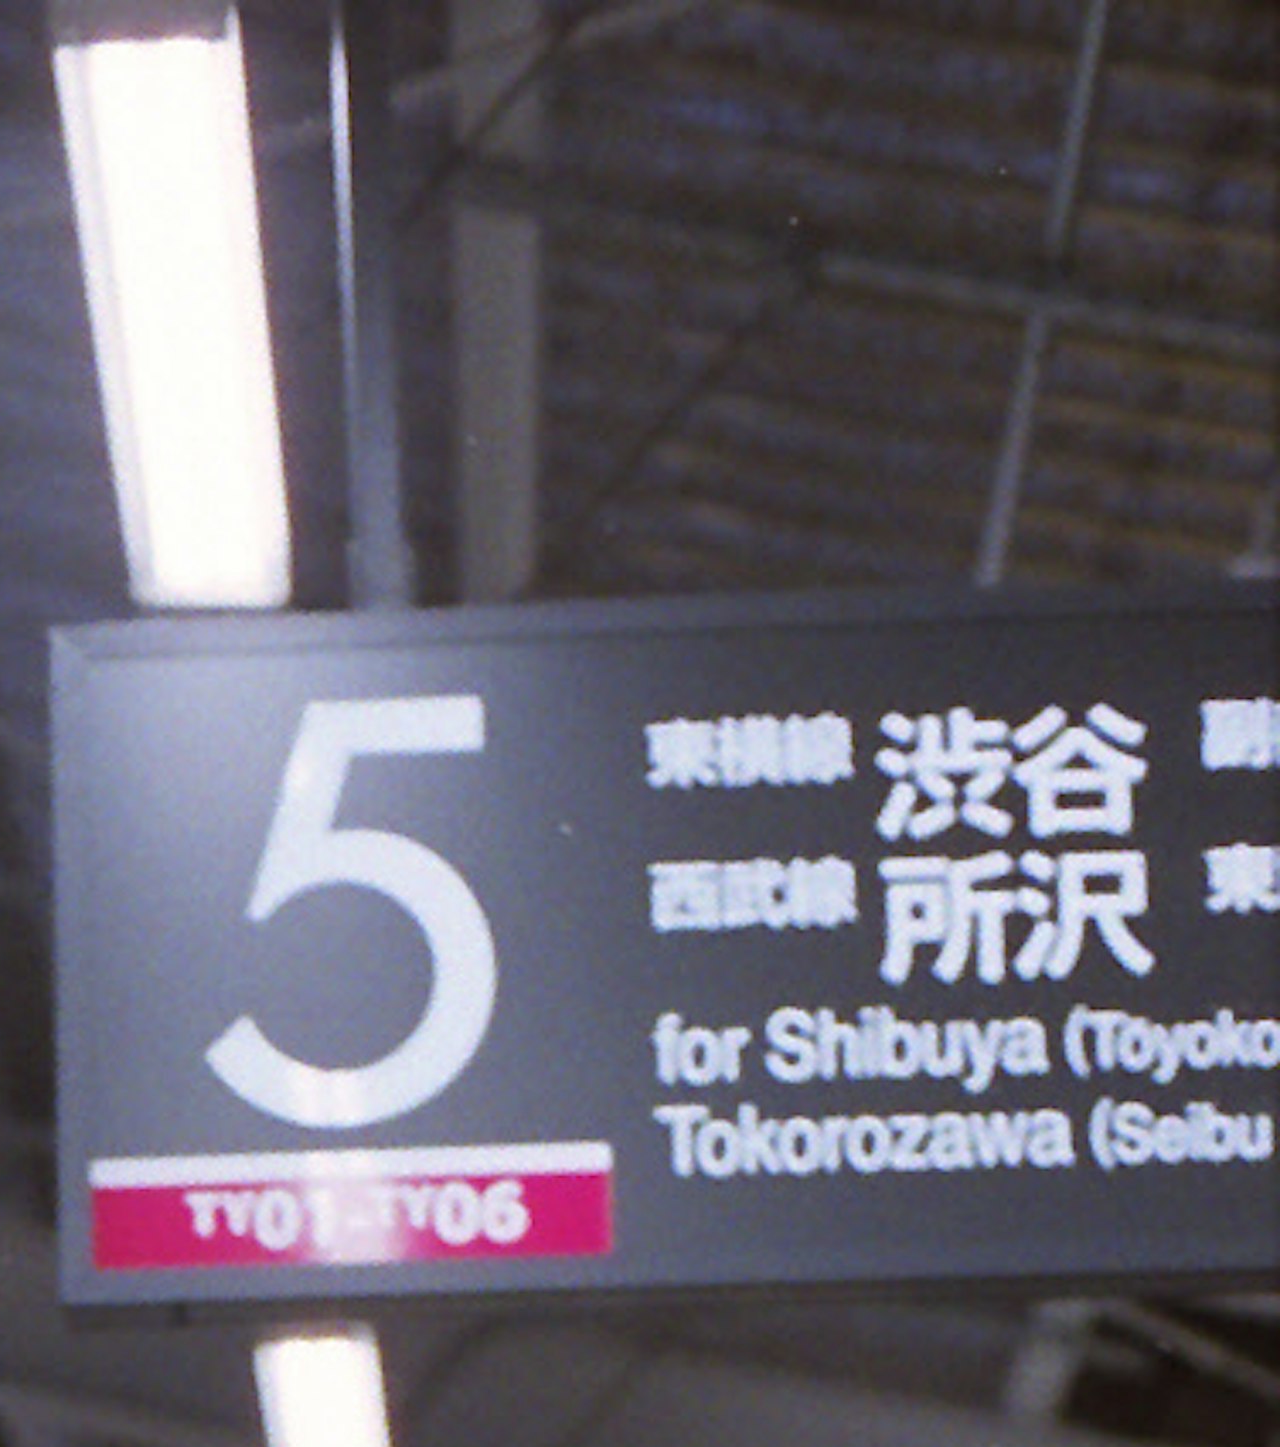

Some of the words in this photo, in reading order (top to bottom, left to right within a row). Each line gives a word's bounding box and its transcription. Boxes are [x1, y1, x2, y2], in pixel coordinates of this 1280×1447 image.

[874, 702, 1149, 841] 渋谷
[205, 694, 498, 1130] 5
[877, 849, 1156, 986] 所沢
[651, 1011, 753, 1087] for
[763, 1004, 1051, 1095] Shibuya
[652, 1102, 1077, 1180] Tokorozawa
